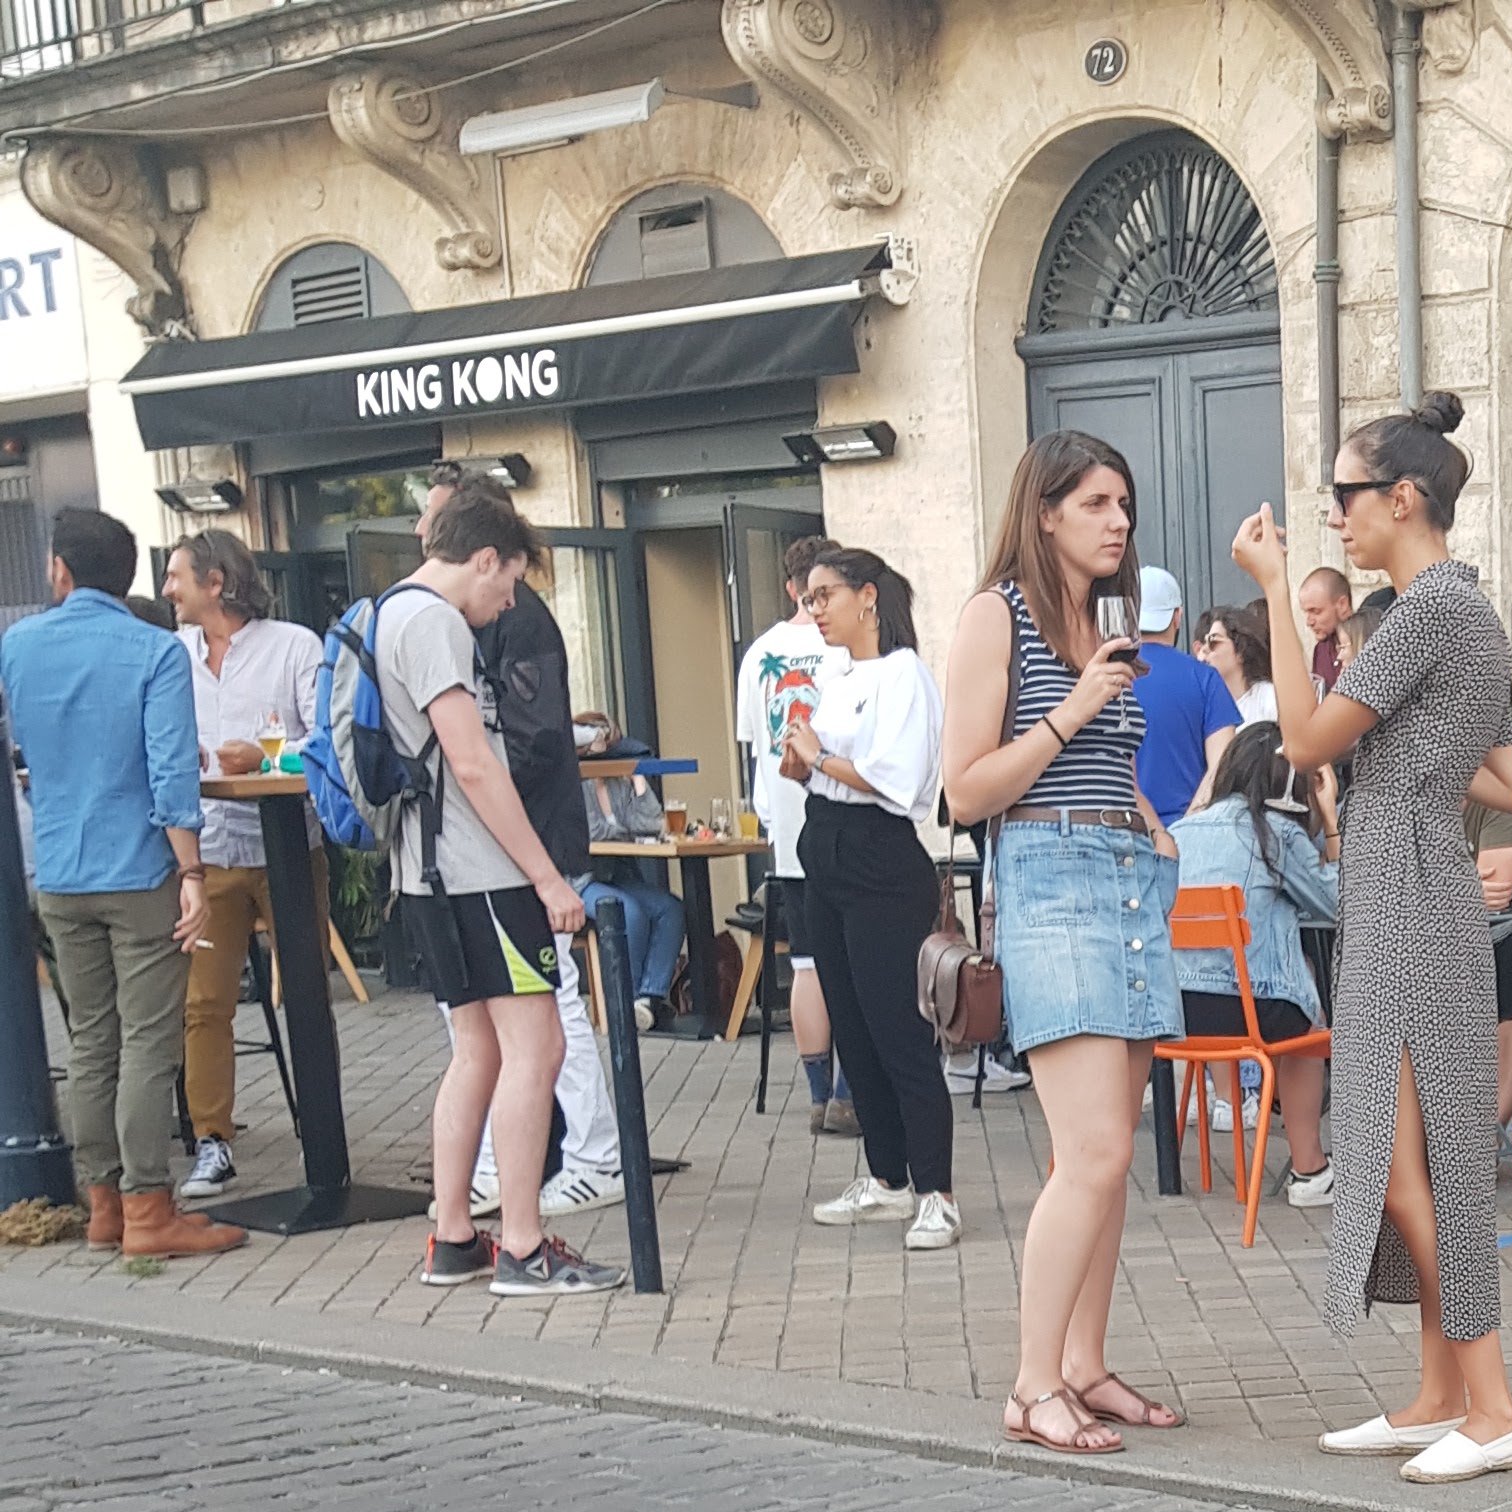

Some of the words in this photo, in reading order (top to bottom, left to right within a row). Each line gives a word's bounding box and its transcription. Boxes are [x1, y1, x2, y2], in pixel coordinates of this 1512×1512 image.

[1092, 47, 1114, 75] 72
[0, 247, 62, 320] RT
[356, 364, 443, 417] KING
[452, 349, 558, 406] KONG
